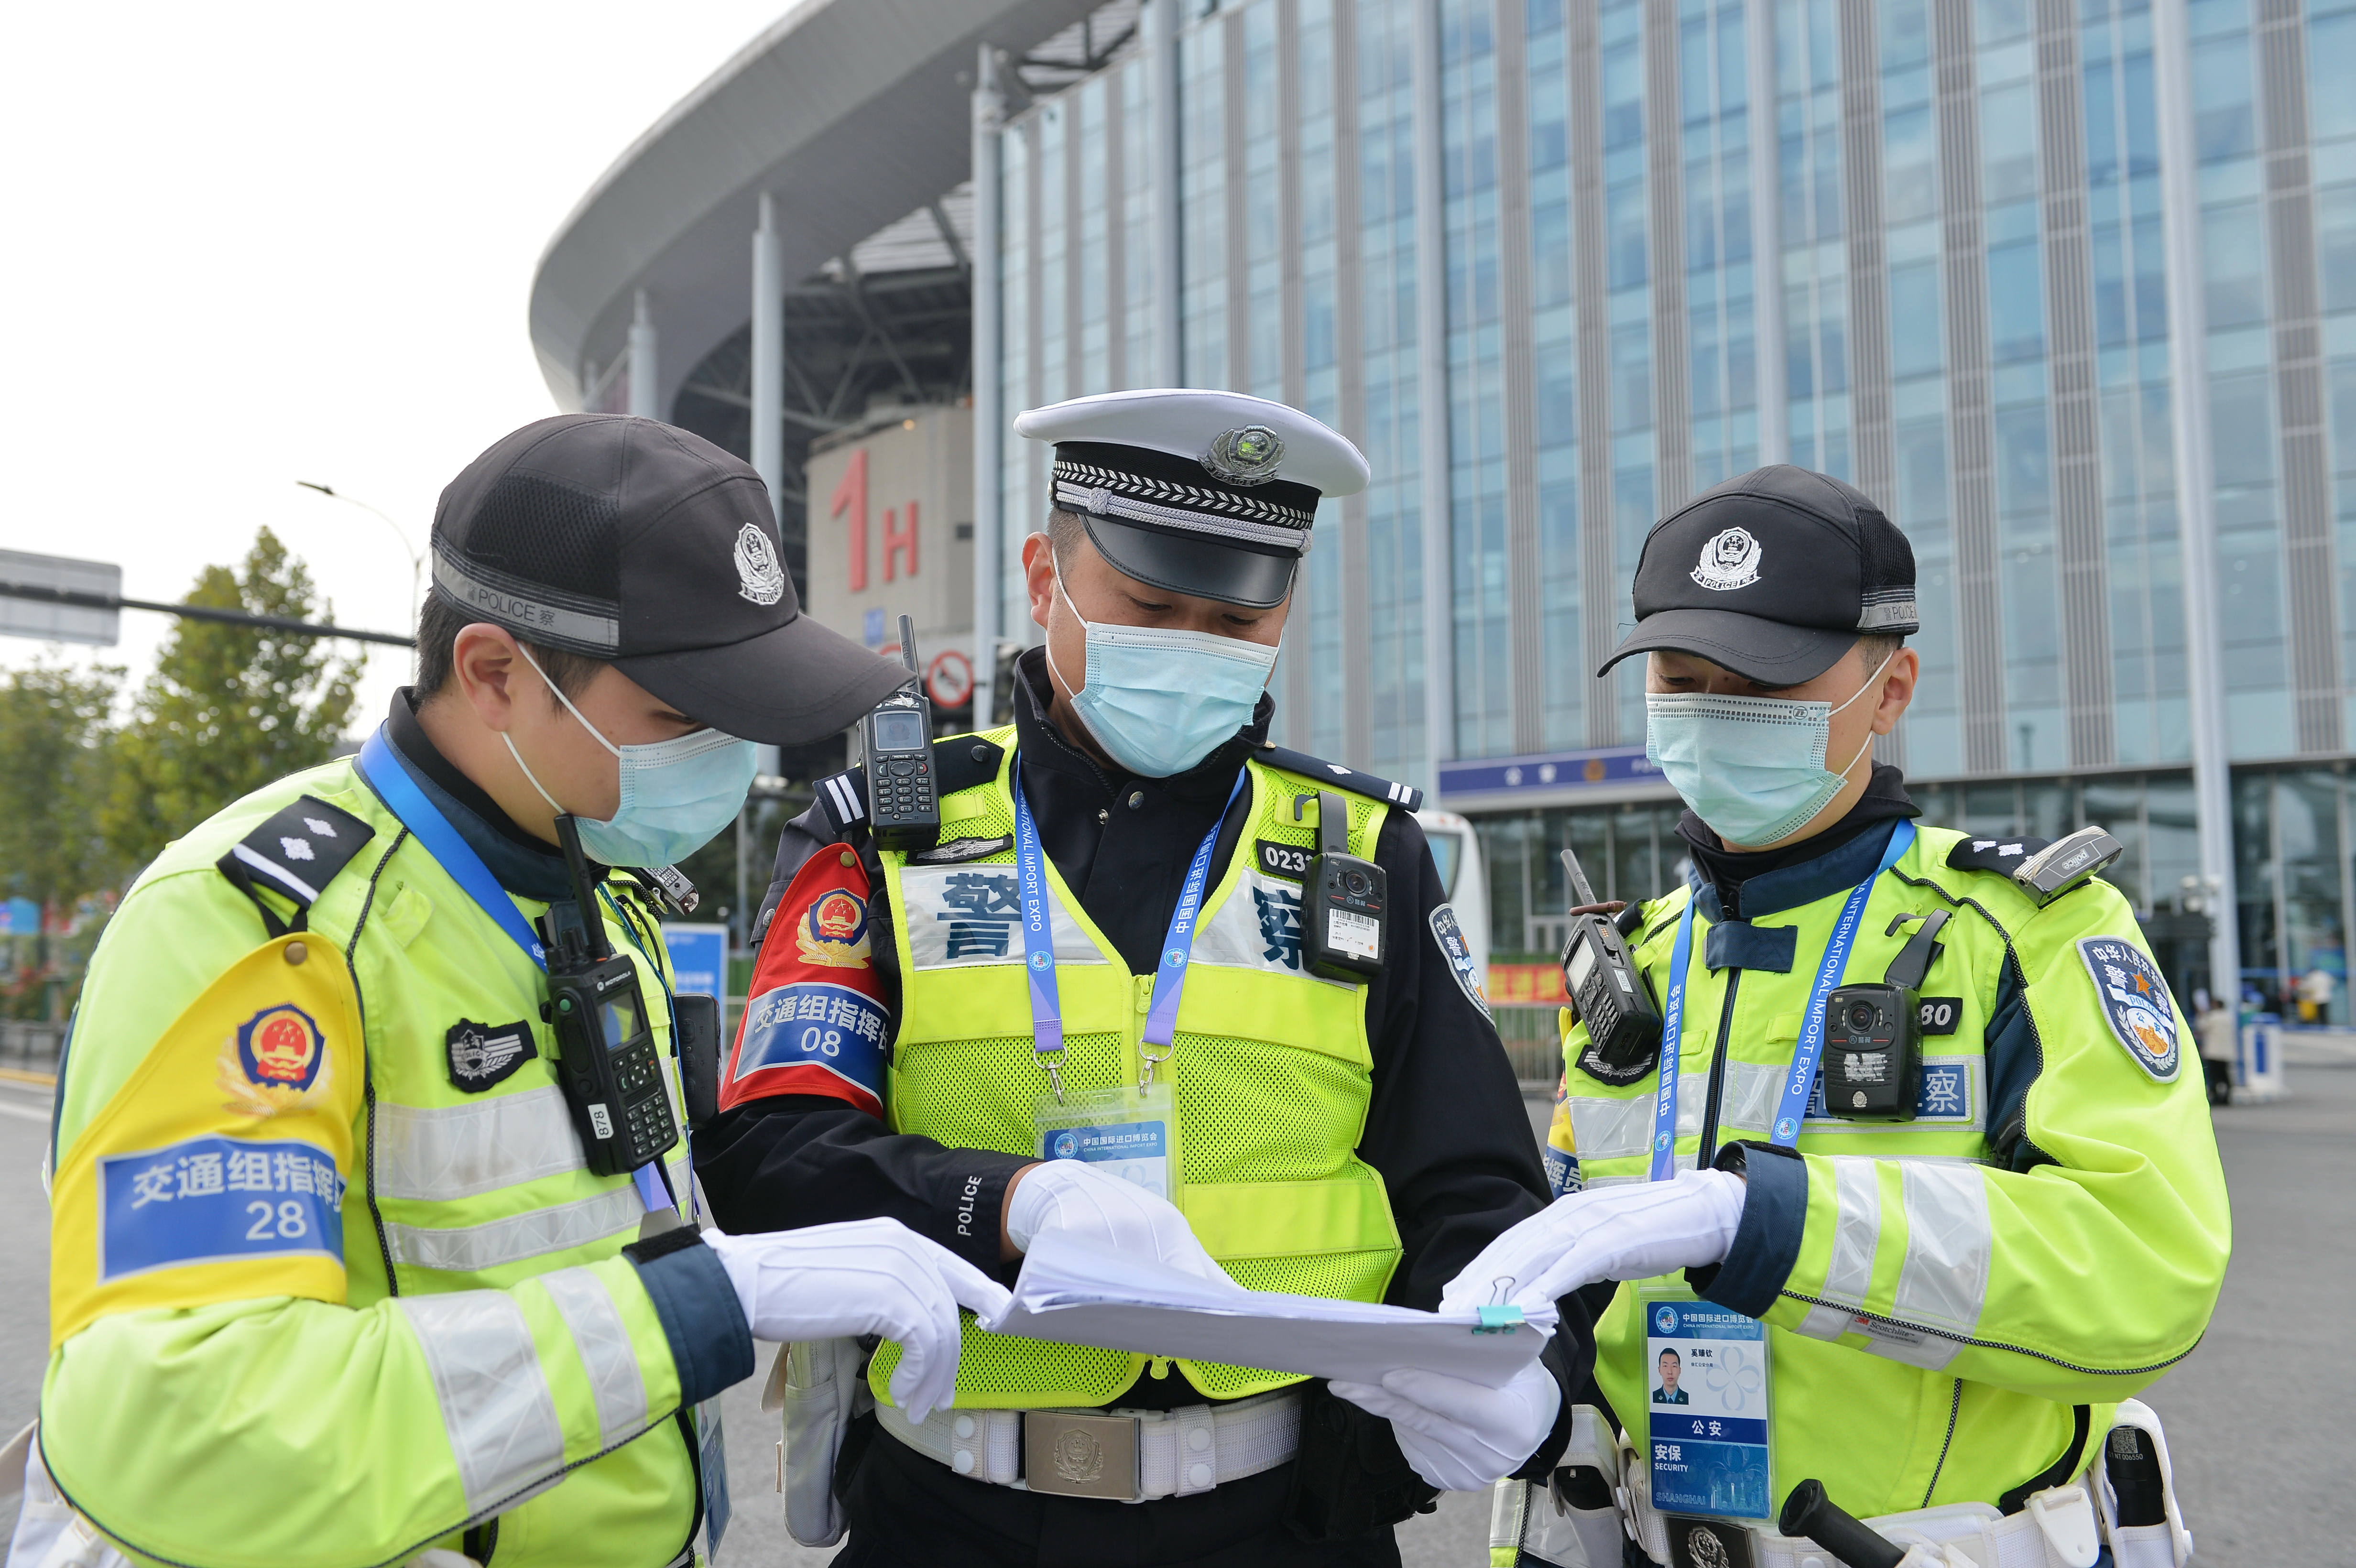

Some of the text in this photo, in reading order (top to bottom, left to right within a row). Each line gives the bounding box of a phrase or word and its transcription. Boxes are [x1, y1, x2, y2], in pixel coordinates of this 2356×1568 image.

[1216, 472, 1252, 486] POLICE
[1705, 579, 1738, 588] POLICE
[479, 588, 535, 622] POLICE
[540, 610, 555, 627] 察
[2062, 848, 2089, 870] police
[1024, 852, 1039, 896] IMPORT
[1028, 899, 1042, 932] EXPO
[1445, 936, 1462, 957] 警
[1817, 897, 1862, 996] INTERNATIONAL
[2129, 995, 2163, 1019] POLICE
[1803, 999, 1826, 1054] IMPORT
[801, 1026, 841, 1057] 08
[1659, 983, 1681, 1117] 中国国际进口博览会
[1791, 1056, 1811, 1095] EXPO
[594, 1110, 609, 1136] 878
[1083, 1132, 1157, 1146] 中国国际进口博览会
[131, 1150, 341, 1212] 交通组指挥
[958, 1175, 982, 1236] POLICE
[246, 1199, 306, 1241] 28
[1683, 1313, 1754, 1324] 中国国际进口博览会
[1854, 1317, 1870, 1326] 3M
[1867, 1328, 1919, 1344] Reflective Material
[1655, 1444, 1681, 1461] 安保
[1655, 1462, 1689, 1472] SECURITY
[1656, 1492, 1706, 1505] SHANGHAI
